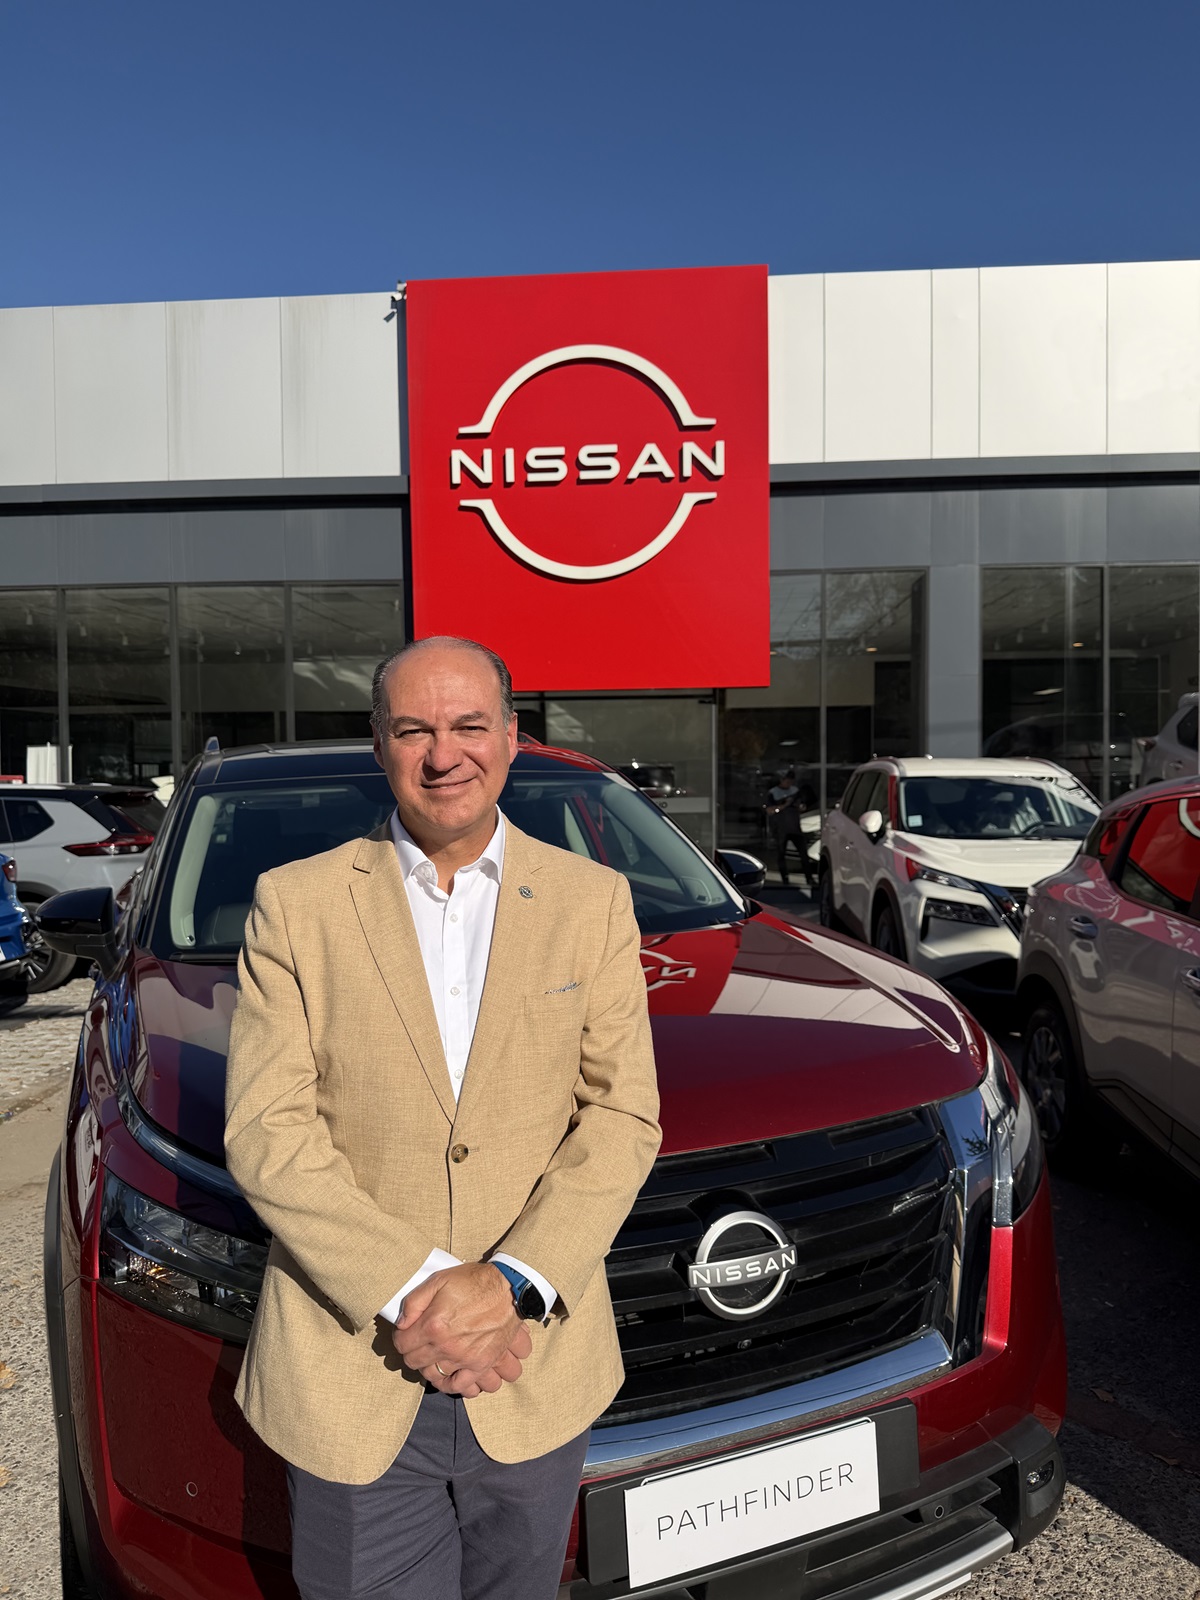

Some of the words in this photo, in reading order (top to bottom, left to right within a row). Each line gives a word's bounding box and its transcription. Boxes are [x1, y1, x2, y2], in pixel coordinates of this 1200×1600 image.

[451, 440, 725, 485] NISSAN
[693, 1250, 796, 1285] NISSAN
[657, 1462, 854, 1540] PATHFINDER
